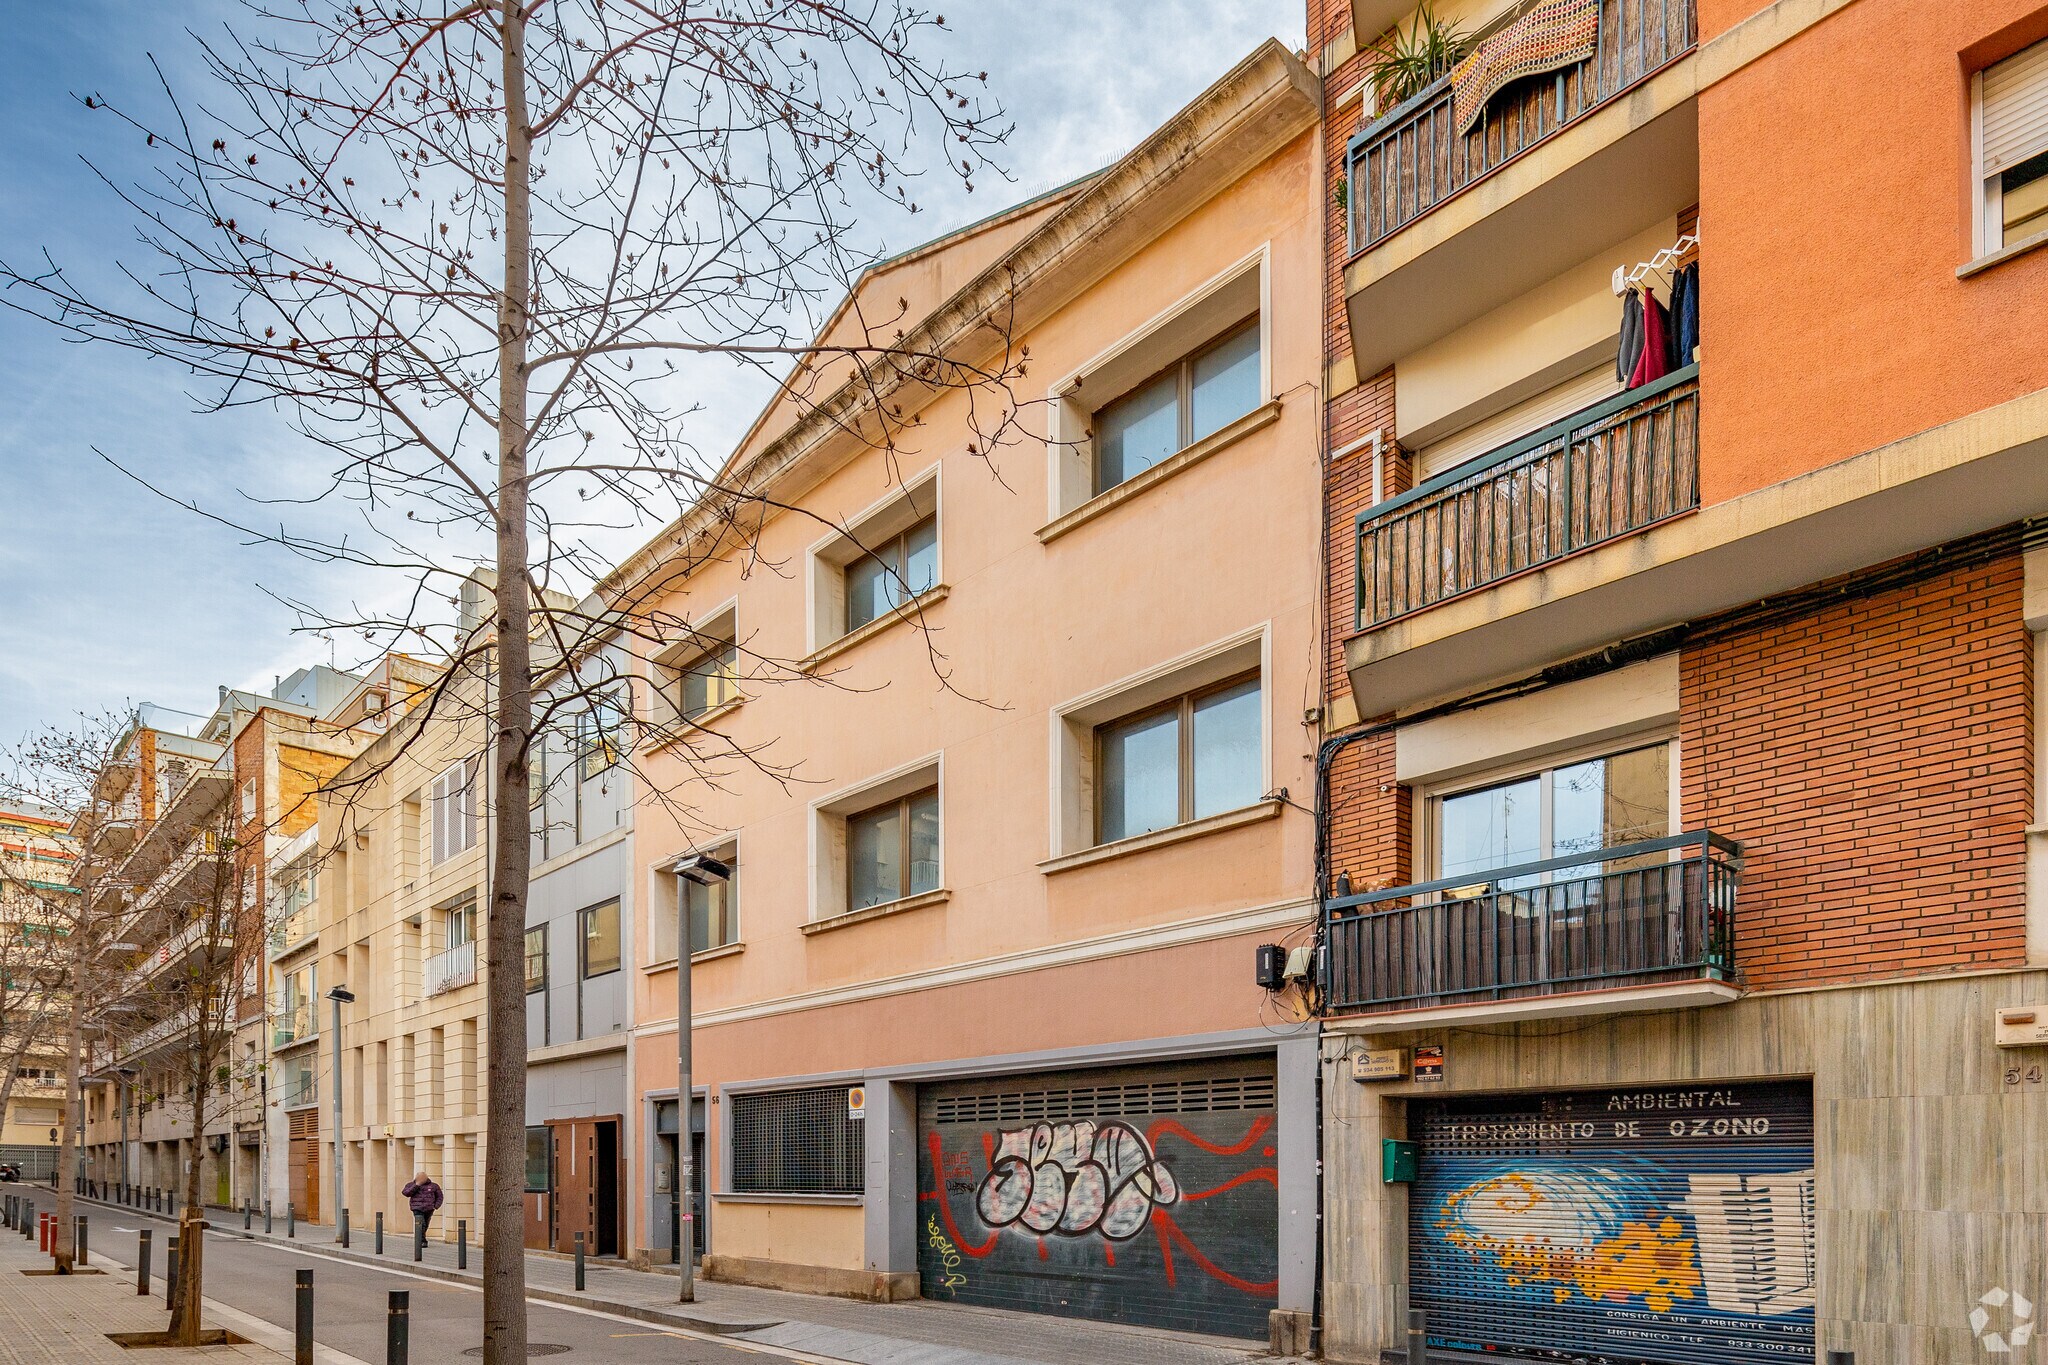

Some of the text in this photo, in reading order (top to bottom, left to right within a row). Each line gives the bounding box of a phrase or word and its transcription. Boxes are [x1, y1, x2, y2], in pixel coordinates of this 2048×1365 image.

[2005, 1065, 2042, 1085] 54
[711, 1095, 720, 1105] 56
[1607, 1090, 1741, 1111] AMBIENTAL
[1442, 1117, 1770, 1141] TRATAMIENTO DE OZONO
[1606, 1310, 1660, 1321] CONSIGA
[1701, 1318, 1766, 1330] AMBIENTE
[1782, 1325, 1813, 1334] MAS
[1426, 1336, 1446, 1347] AXE
[1727, 1340, 1752, 1348] 933
[1756, 1342, 1784, 1351] 300
[1788, 1345, 1812, 1354] 341
